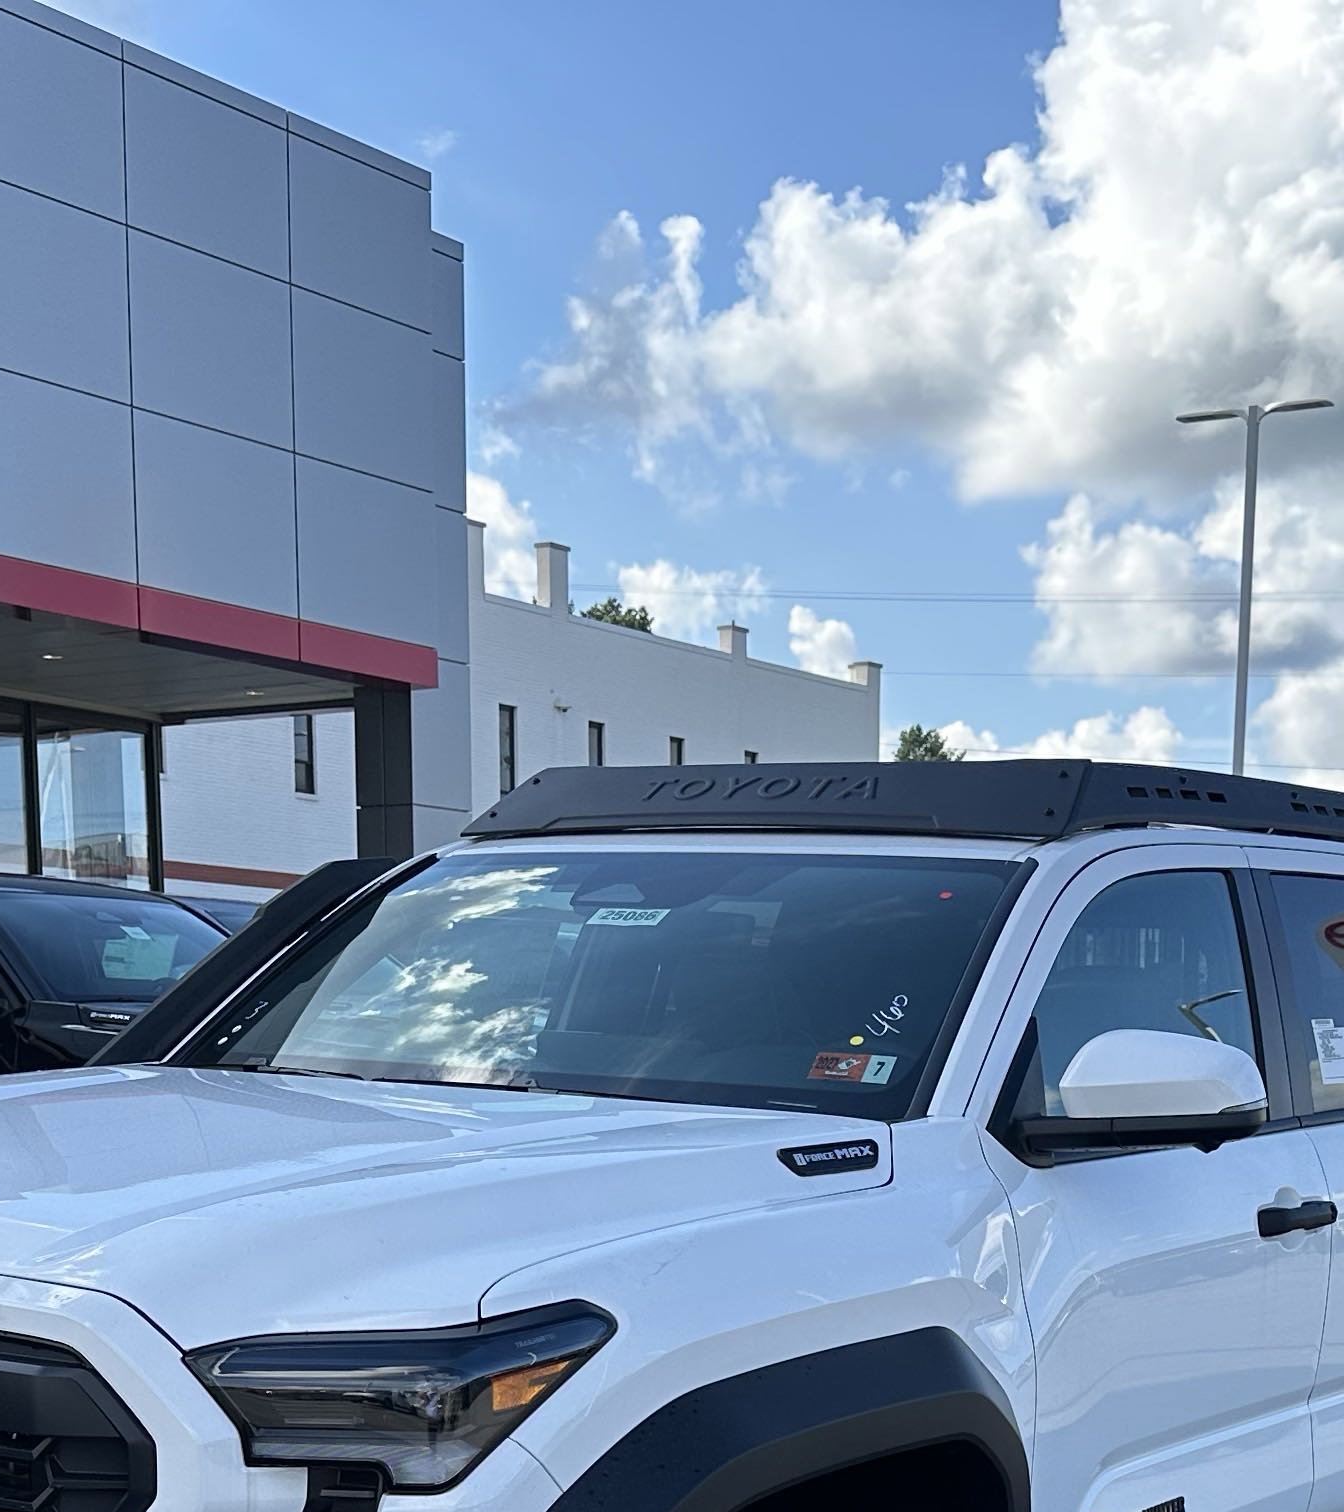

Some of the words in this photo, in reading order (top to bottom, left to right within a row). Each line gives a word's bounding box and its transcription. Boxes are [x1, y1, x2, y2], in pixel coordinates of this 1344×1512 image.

[642, 777, 879, 800] TOYOTA
[873, 1061, 886, 1077] 7
[834, 1146, 874, 1159] MAX
